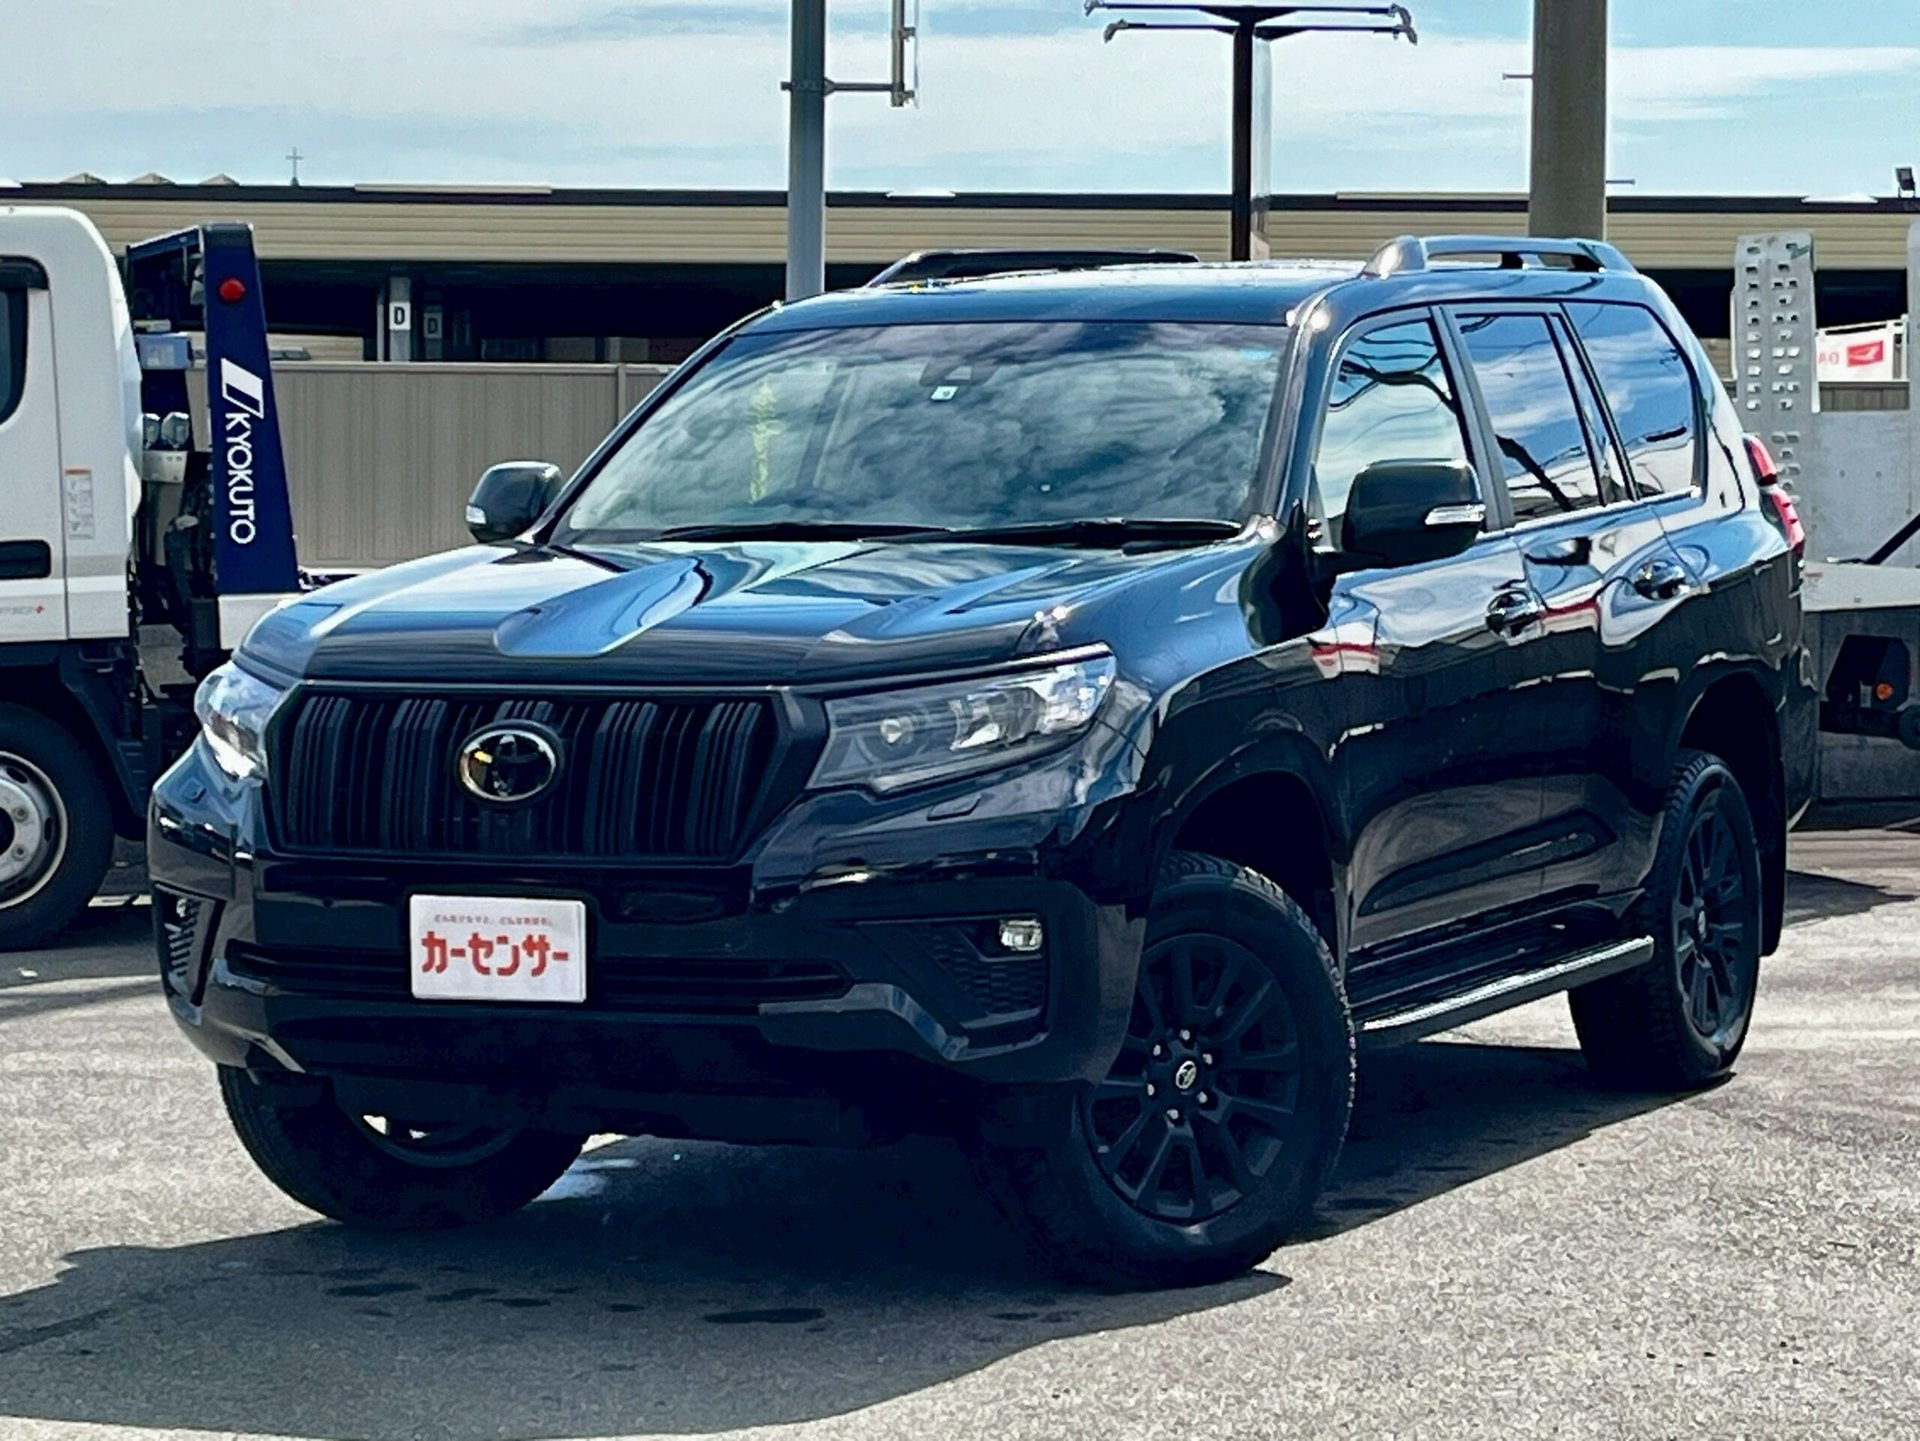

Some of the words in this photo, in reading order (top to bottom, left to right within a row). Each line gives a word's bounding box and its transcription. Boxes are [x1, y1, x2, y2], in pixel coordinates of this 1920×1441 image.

[394, 306, 405, 325] D
[427, 317, 438, 334] D
[225, 412, 256, 544] KYOKUTO
[421, 930, 569, 977] カーセンサー
